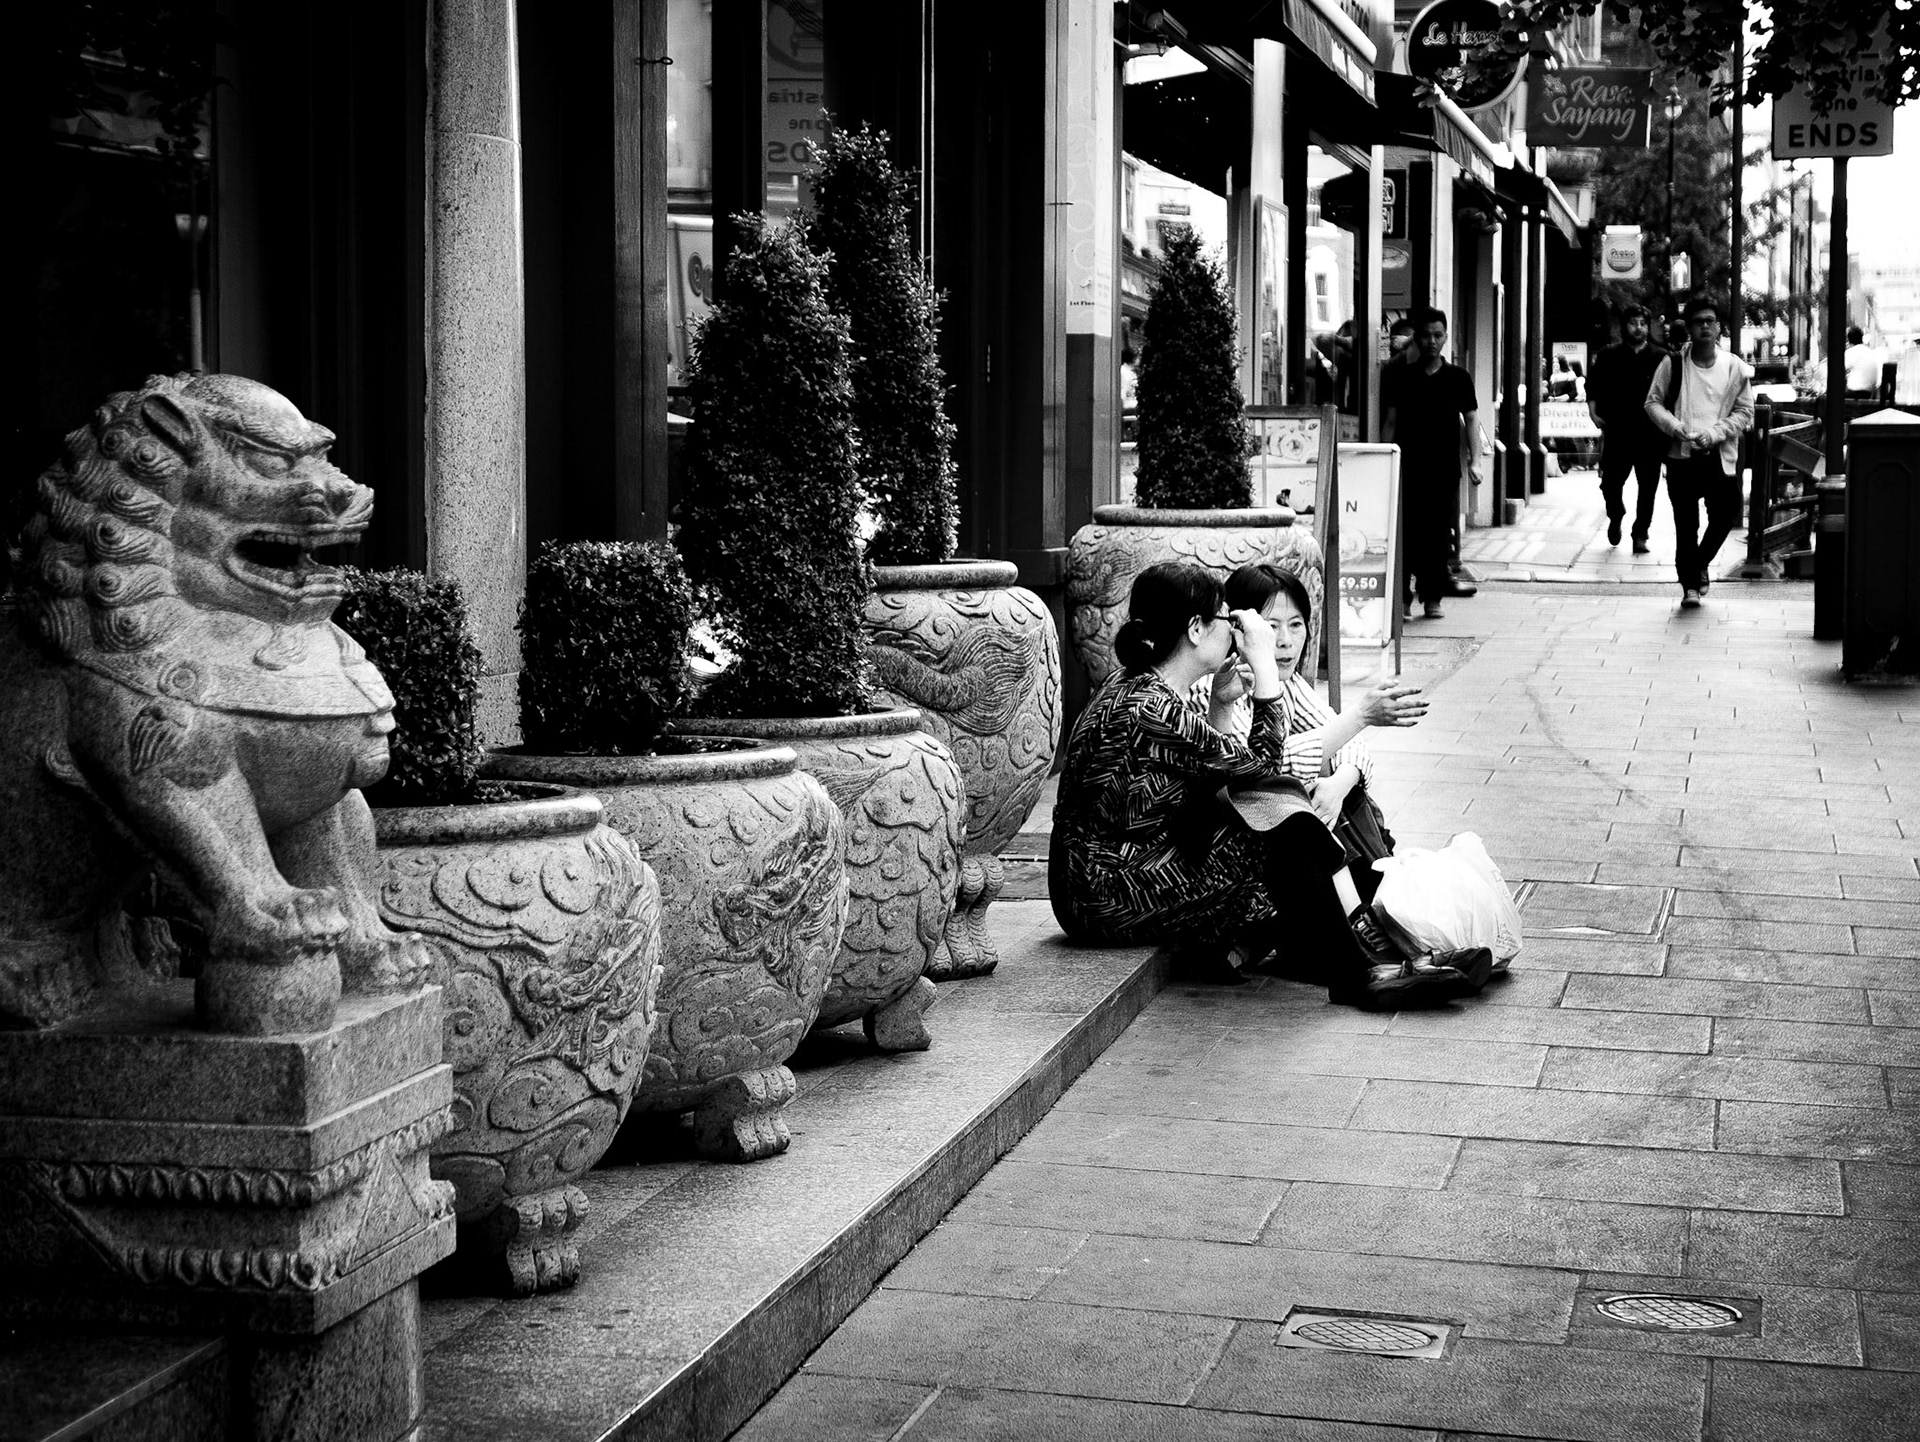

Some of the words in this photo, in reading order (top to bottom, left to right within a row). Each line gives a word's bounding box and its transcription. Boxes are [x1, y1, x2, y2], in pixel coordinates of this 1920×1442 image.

[1422, 22, 1448, 46] Le
[1823, 97, 1858, 111] one
[1542, 97, 1636, 141] Sayang
[1788, 122, 1878, 148] ENDS
[1543, 408, 1588, 418] Diverte
